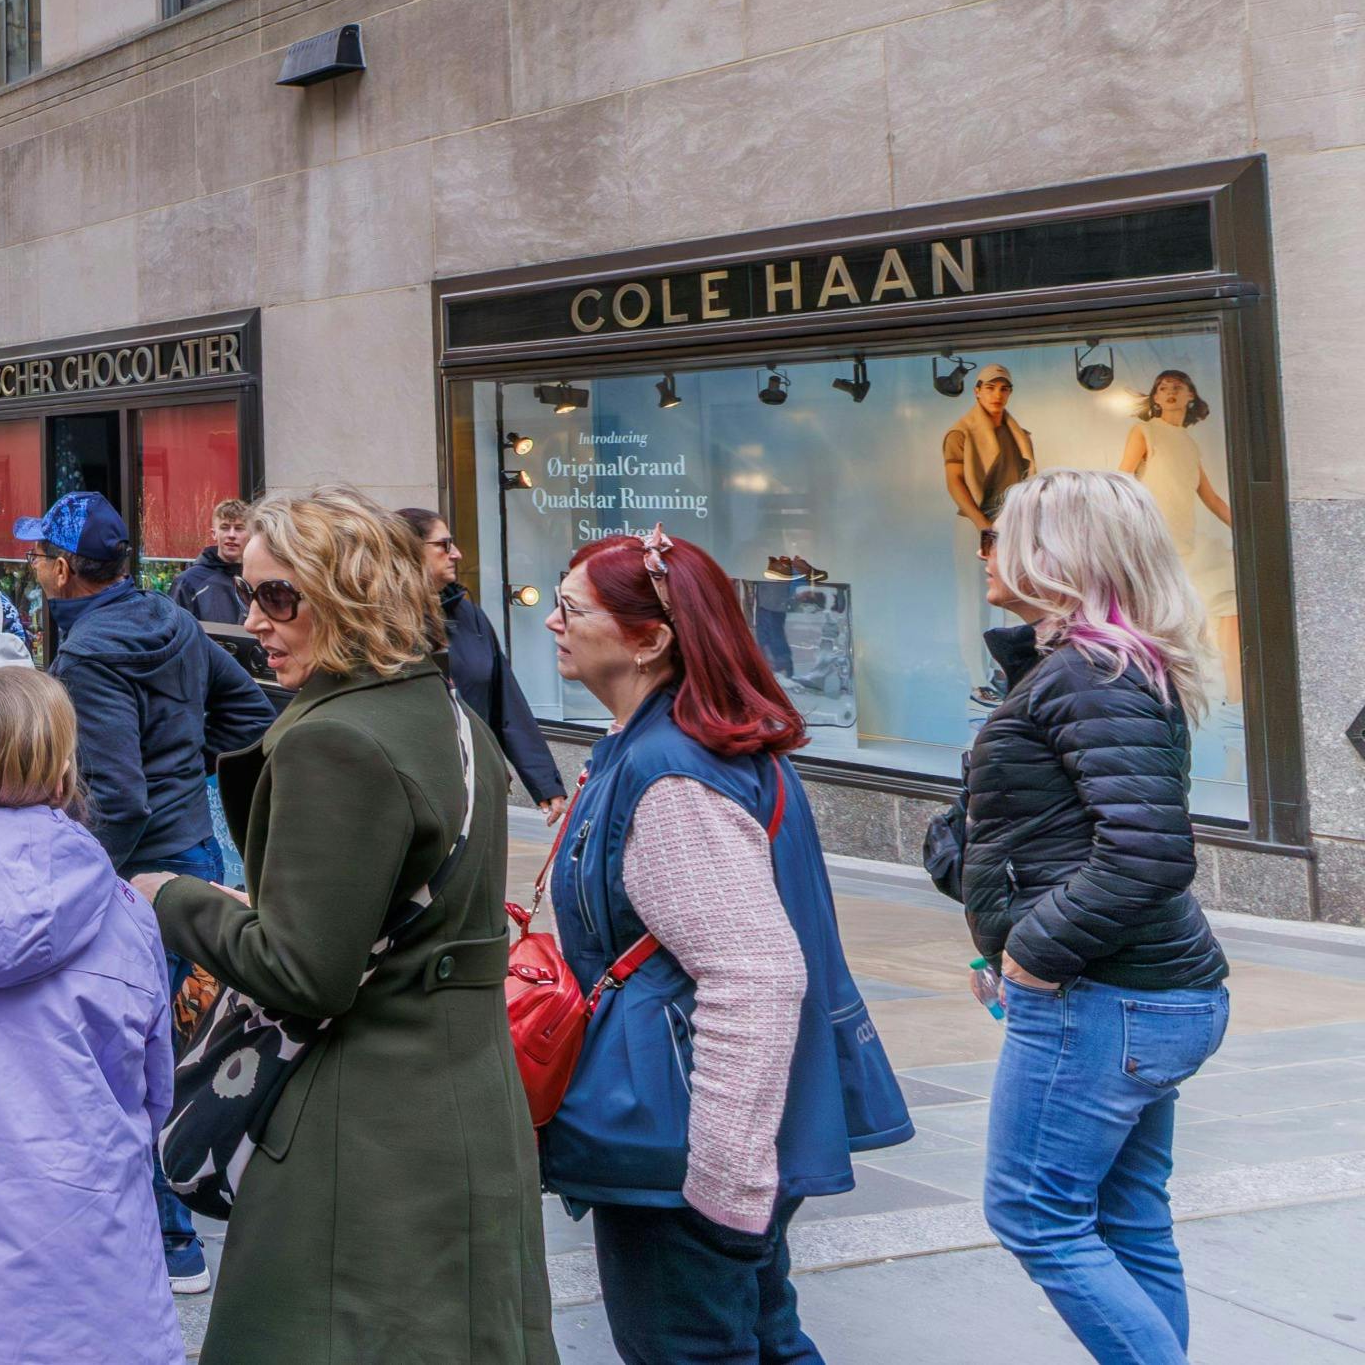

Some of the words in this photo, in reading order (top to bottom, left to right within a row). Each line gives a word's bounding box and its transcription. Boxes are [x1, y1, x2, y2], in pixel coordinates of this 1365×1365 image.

[570, 270, 731, 333] COLE
[764, 238, 975, 313] HAAN
[60, 333, 242, 391] CHOCOLATIER
[578, 430, 649, 448] Introducing
[547, 454, 687, 484] ØriginalGrand
[531, 487, 616, 515] Quadstar
[619, 487, 708, 519] Running
